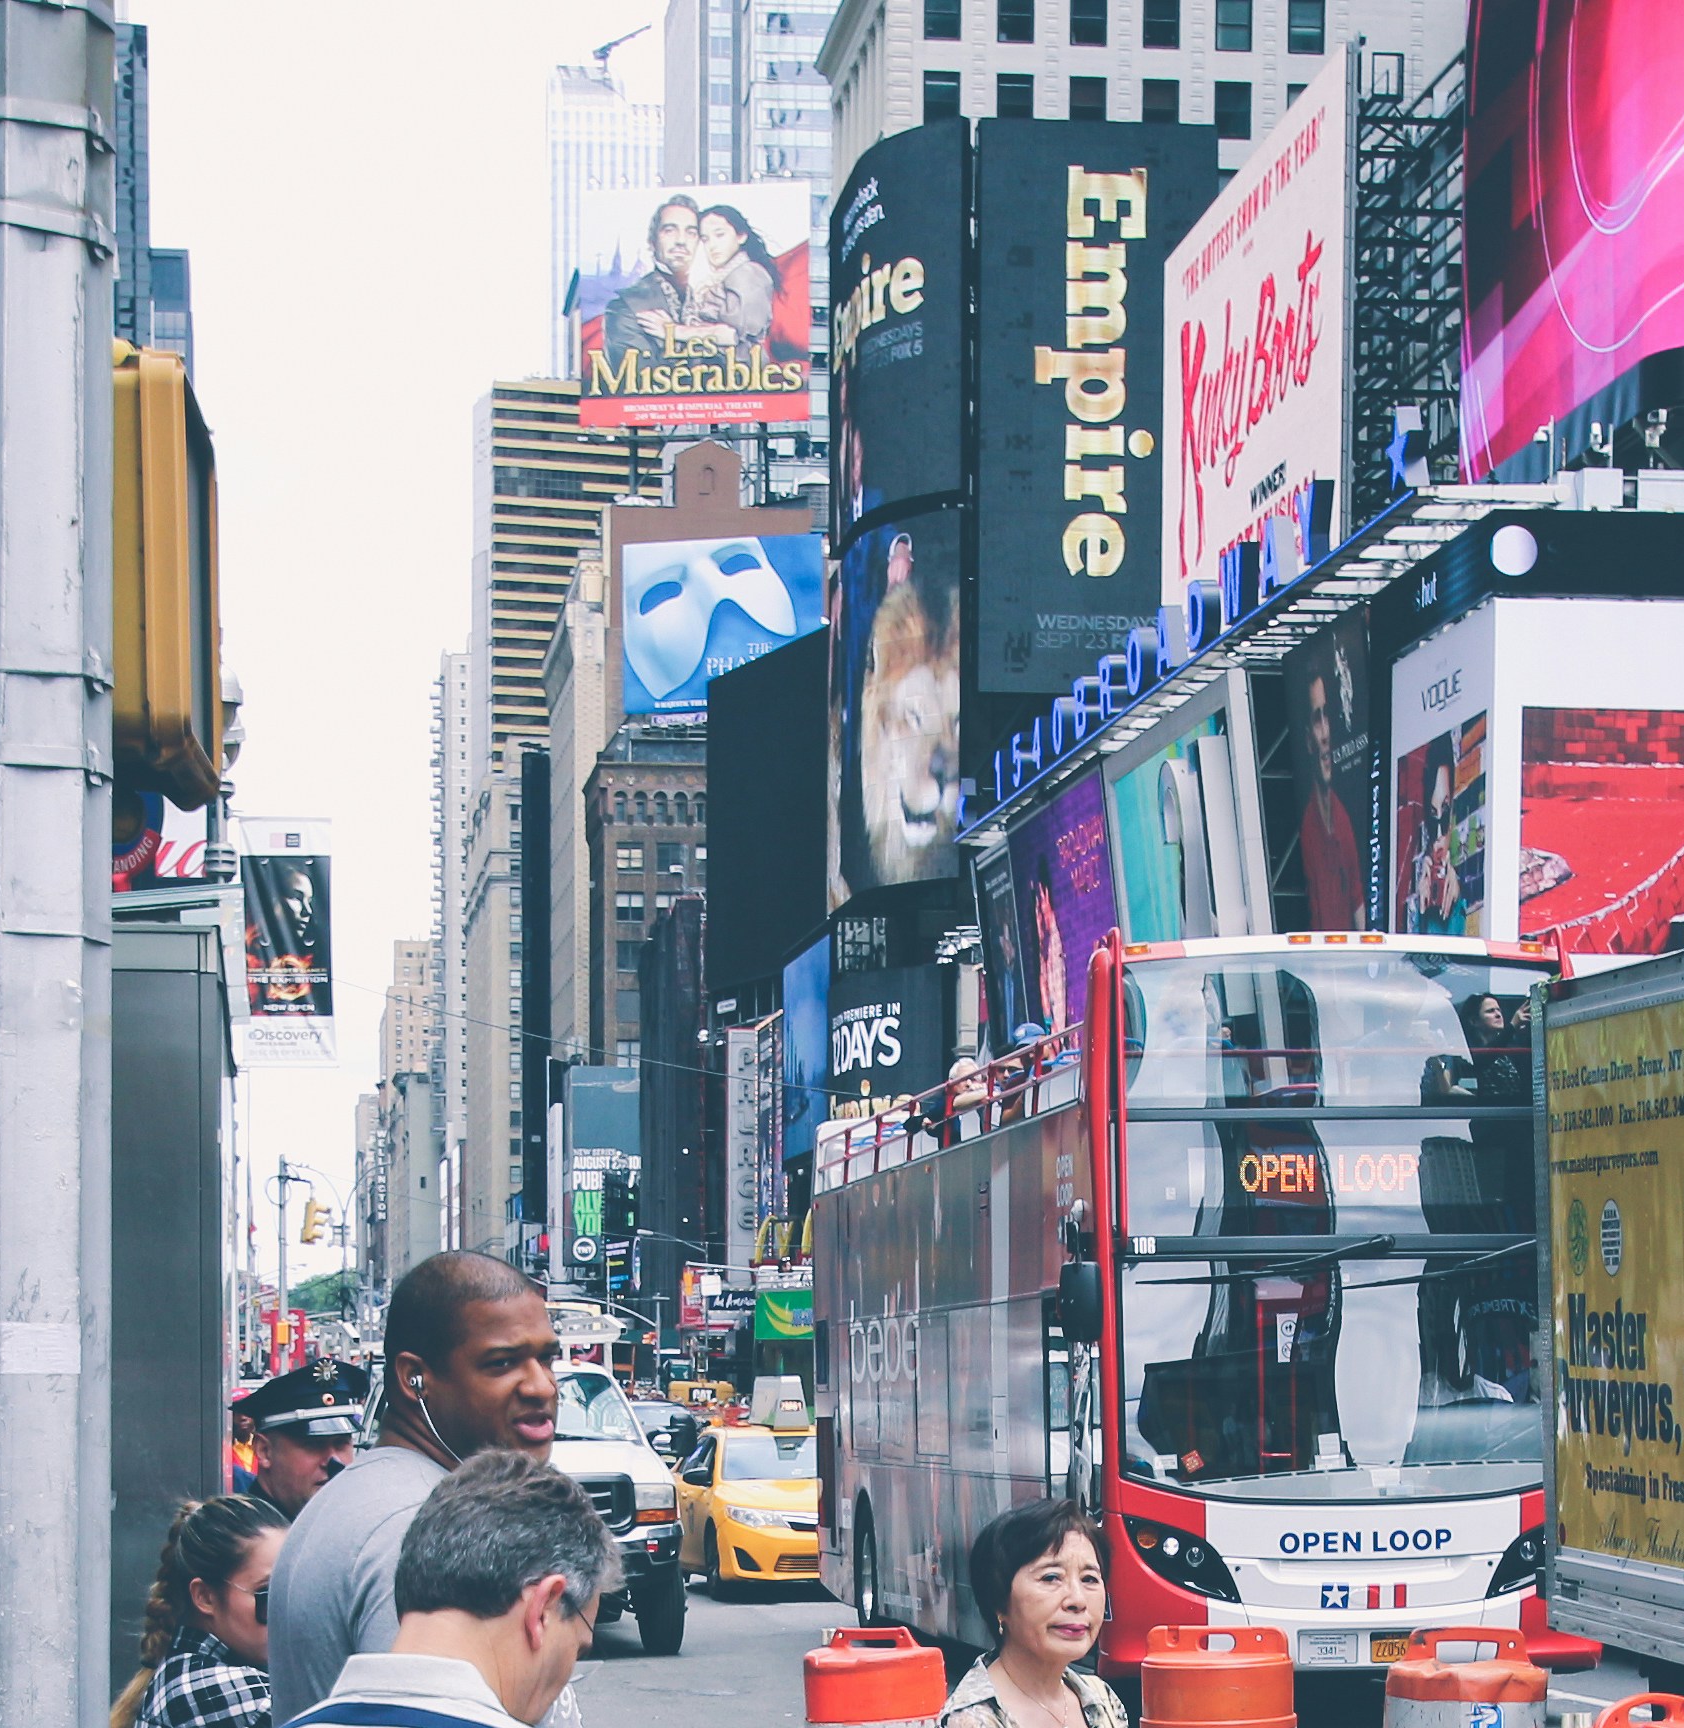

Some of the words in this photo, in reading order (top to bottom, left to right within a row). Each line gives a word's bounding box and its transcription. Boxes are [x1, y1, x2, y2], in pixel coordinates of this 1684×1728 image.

[1236, 195, 1260, 242] SHOW
[1262, 171, 1273, 208] OF
[1274, 153, 1292, 192] THE
[663, 322, 718, 360] Les
[587, 343, 804, 397] Misérables
[1034, 164, 1155, 579] Empire
[1072, 480, 1320, 742] BROADWAY
[1035, 631, 1074, 650] SEPT
[1077, 630, 1106, 649] 23
[247, 976, 269, 984] THE
[270, 975, 329, 984] EXHIBITION
[263, 1004, 286, 1012] NOW
[288, 1003, 315, 1012] OPEN
[886, 1001, 902, 1016] IN
[249, 1028, 323, 1045] Discovery
[840, 1016, 902, 1074] DAYS
[1561, 1067, 1580, 1090] Food
[1580, 1063, 1609, 1087] Center
[1609, 1060, 1637, 1084] Drive,
[1636, 1054, 1667, 1079] Bronx,
[1667, 1049, 1683, 1072] NY
[376, 1129, 389, 1221] WELLINGTON
[573, 1155, 609, 1170] AUGUST
[1239, 1153, 1317, 1195] OPEN
[1336, 1152, 1417, 1194] LOOP
[849, 1294, 921, 1384] bebe
[1567, 1291, 1649, 1373] Master
[692, 1388, 713, 1402] CAT
[1585, 1462, 1647, 1505] Specializing
[1647, 1471, 1660, 1496] in
[1279, 1529, 1363, 1556] OPEN
[1371, 1526, 1453, 1553] LOOP
